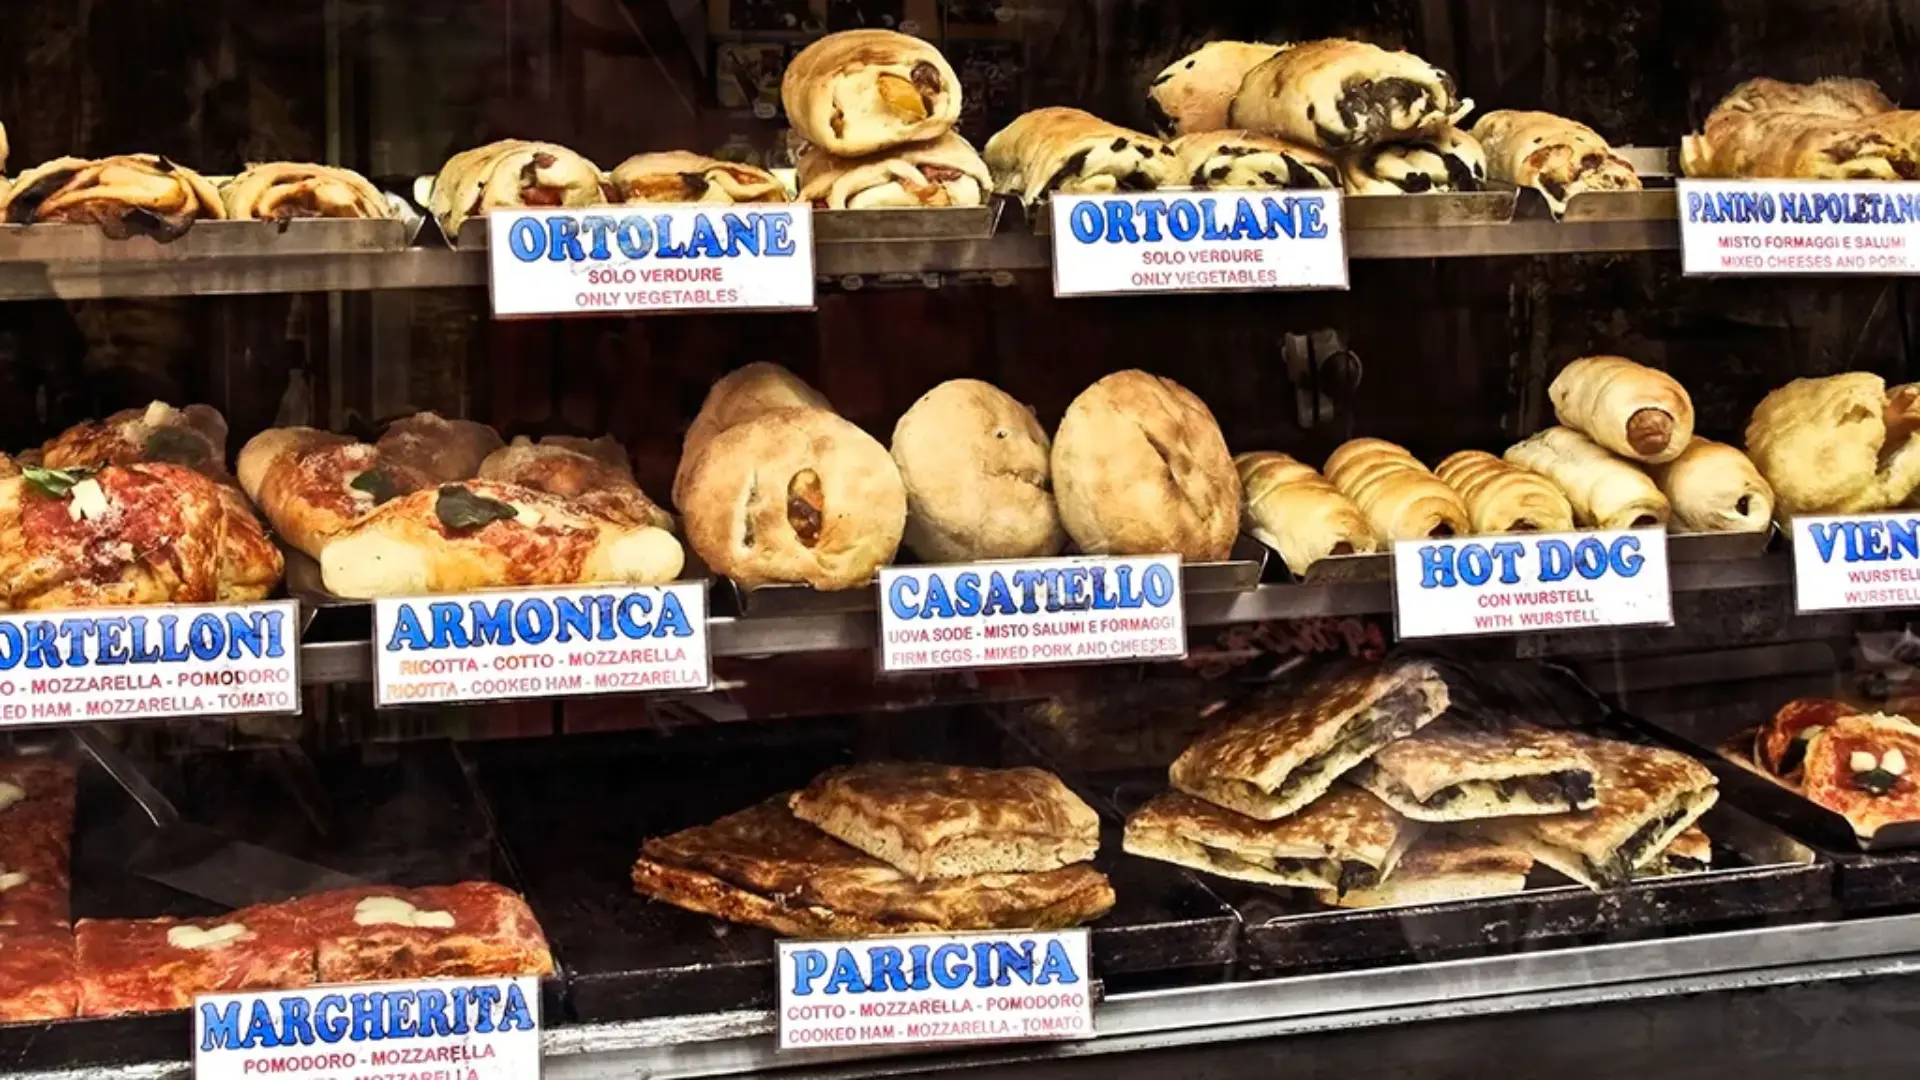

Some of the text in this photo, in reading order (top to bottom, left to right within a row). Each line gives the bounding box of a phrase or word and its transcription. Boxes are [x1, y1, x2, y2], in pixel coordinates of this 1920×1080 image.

[1069, 196, 1328, 244] ORTOLANE
[1688, 191, 1776, 224] PANINO
[508, 212, 796, 262] ORTOLANE
[1719, 236, 1906, 249] MISTO FORMAGGI E SALUMI
[1142, 249, 1264, 265] SOLO VERDURE
[1722, 256, 1763, 267] MIXED
[1768, 256, 1832, 268] CHEESES
[1837, 256, 1864, 266] AND
[588, 267, 723, 284] SOLO VERDURE
[1131, 270, 1278, 285] ONLY VEGETABLES
[576, 289, 738, 306] ONLY VEGETABLES
[1808, 519, 1920, 563] VIEN
[1418, 535, 1646, 588] HOT DOG
[888, 562, 1174, 620] CASATIELLO
[1478, 590, 1593, 608] CON WURSTELL
[385, 591, 694, 652] ARMONICA
[889, 629, 930, 643] UOVA
[933, 626, 973, 642] SODE
[984, 624, 1029, 638] MISTO
[1032, 621, 1084, 636] SALUMI
[1088, 620, 1097, 633] E
[1100, 616, 1175, 632] FORMAGGI
[1475, 610, 1600, 628] WITH WURSTELL
[400, 658, 478, 675] RICOTTA
[493, 654, 554, 671] COTTO
[569, 648, 685, 666] MOZZARELLA
[893, 651, 927, 663] FIRM
[932, 649, 972, 662] EGGS
[984, 646, 1028, 660] MIXED
[1077, 642, 1107, 654] AND
[1111, 639, 1178, 656] CHEESES
[31, 673, 162, 694] MOZZARELLA
[178, 668, 289, 686] POMODORO
[388, 682, 459, 700] RICOTTA
[471, 677, 541, 694] COOKED
[546, 675, 581, 690] HAM
[595, 671, 702, 690] MOZZARELLA
[0, 704, 27, 720] ED
[32, 702, 71, 717] HAM
[86, 696, 205, 716] MOZZARELLA
[217, 692, 290, 710] TOMATO
[791, 938, 1080, 997] PARIGINA
[199, 983, 535, 1051] MARGHERITA
[787, 1005, 846, 1020] COTTO
[860, 999, 973, 1017] MOZZARELLA
[987, 994, 1083, 1011] POMODORO
[789, 1028, 856, 1043] COOKED
[860, 1025, 894, 1039] HAM
[907, 1020, 1011, 1038] MOZZARELLA
[1023, 1016, 1084, 1032] TOMATO
[244, 1053, 356, 1074] POMODORO
[371, 1044, 495, 1066] MOZZARELLA
